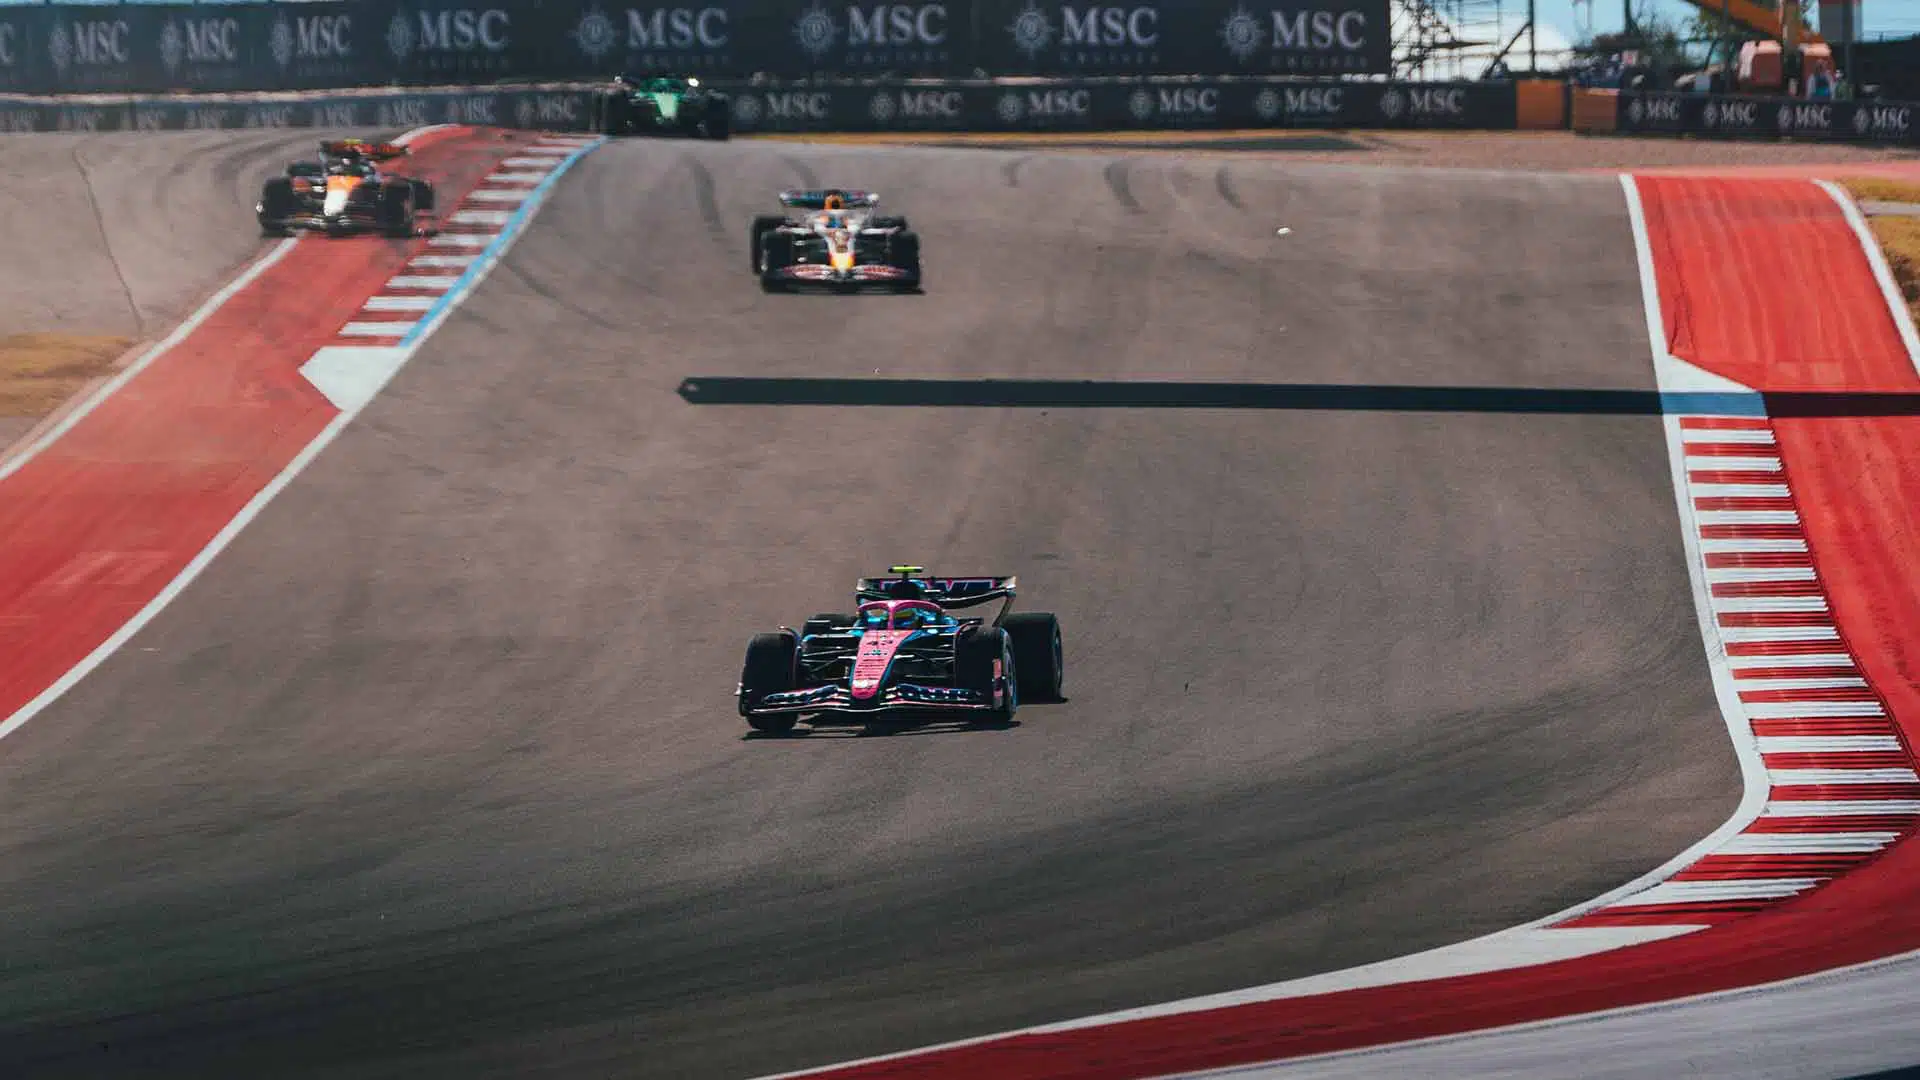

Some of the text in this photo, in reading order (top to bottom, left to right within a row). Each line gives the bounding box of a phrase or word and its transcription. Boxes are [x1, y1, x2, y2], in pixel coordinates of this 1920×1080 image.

[72, 20, 129, 63] MSC
[184, 18, 238, 61] MSC
[297, 16, 350, 56] MSC
[419, 10, 508, 48] MSC
[625, 7, 727, 47] MSC
[848, 5, 946, 43] MSC
[1061, 6, 1159, 46] MSC
[1271, 10, 1366, 49] MSC
[767, 93, 830, 117] MSC
[900, 92, 962, 116] MSC
[1028, 90, 1089, 114] MSC
[1159, 88, 1219, 112] MSC
[1284, 88, 1344, 113] MSC
[1409, 88, 1465, 113] MSC
